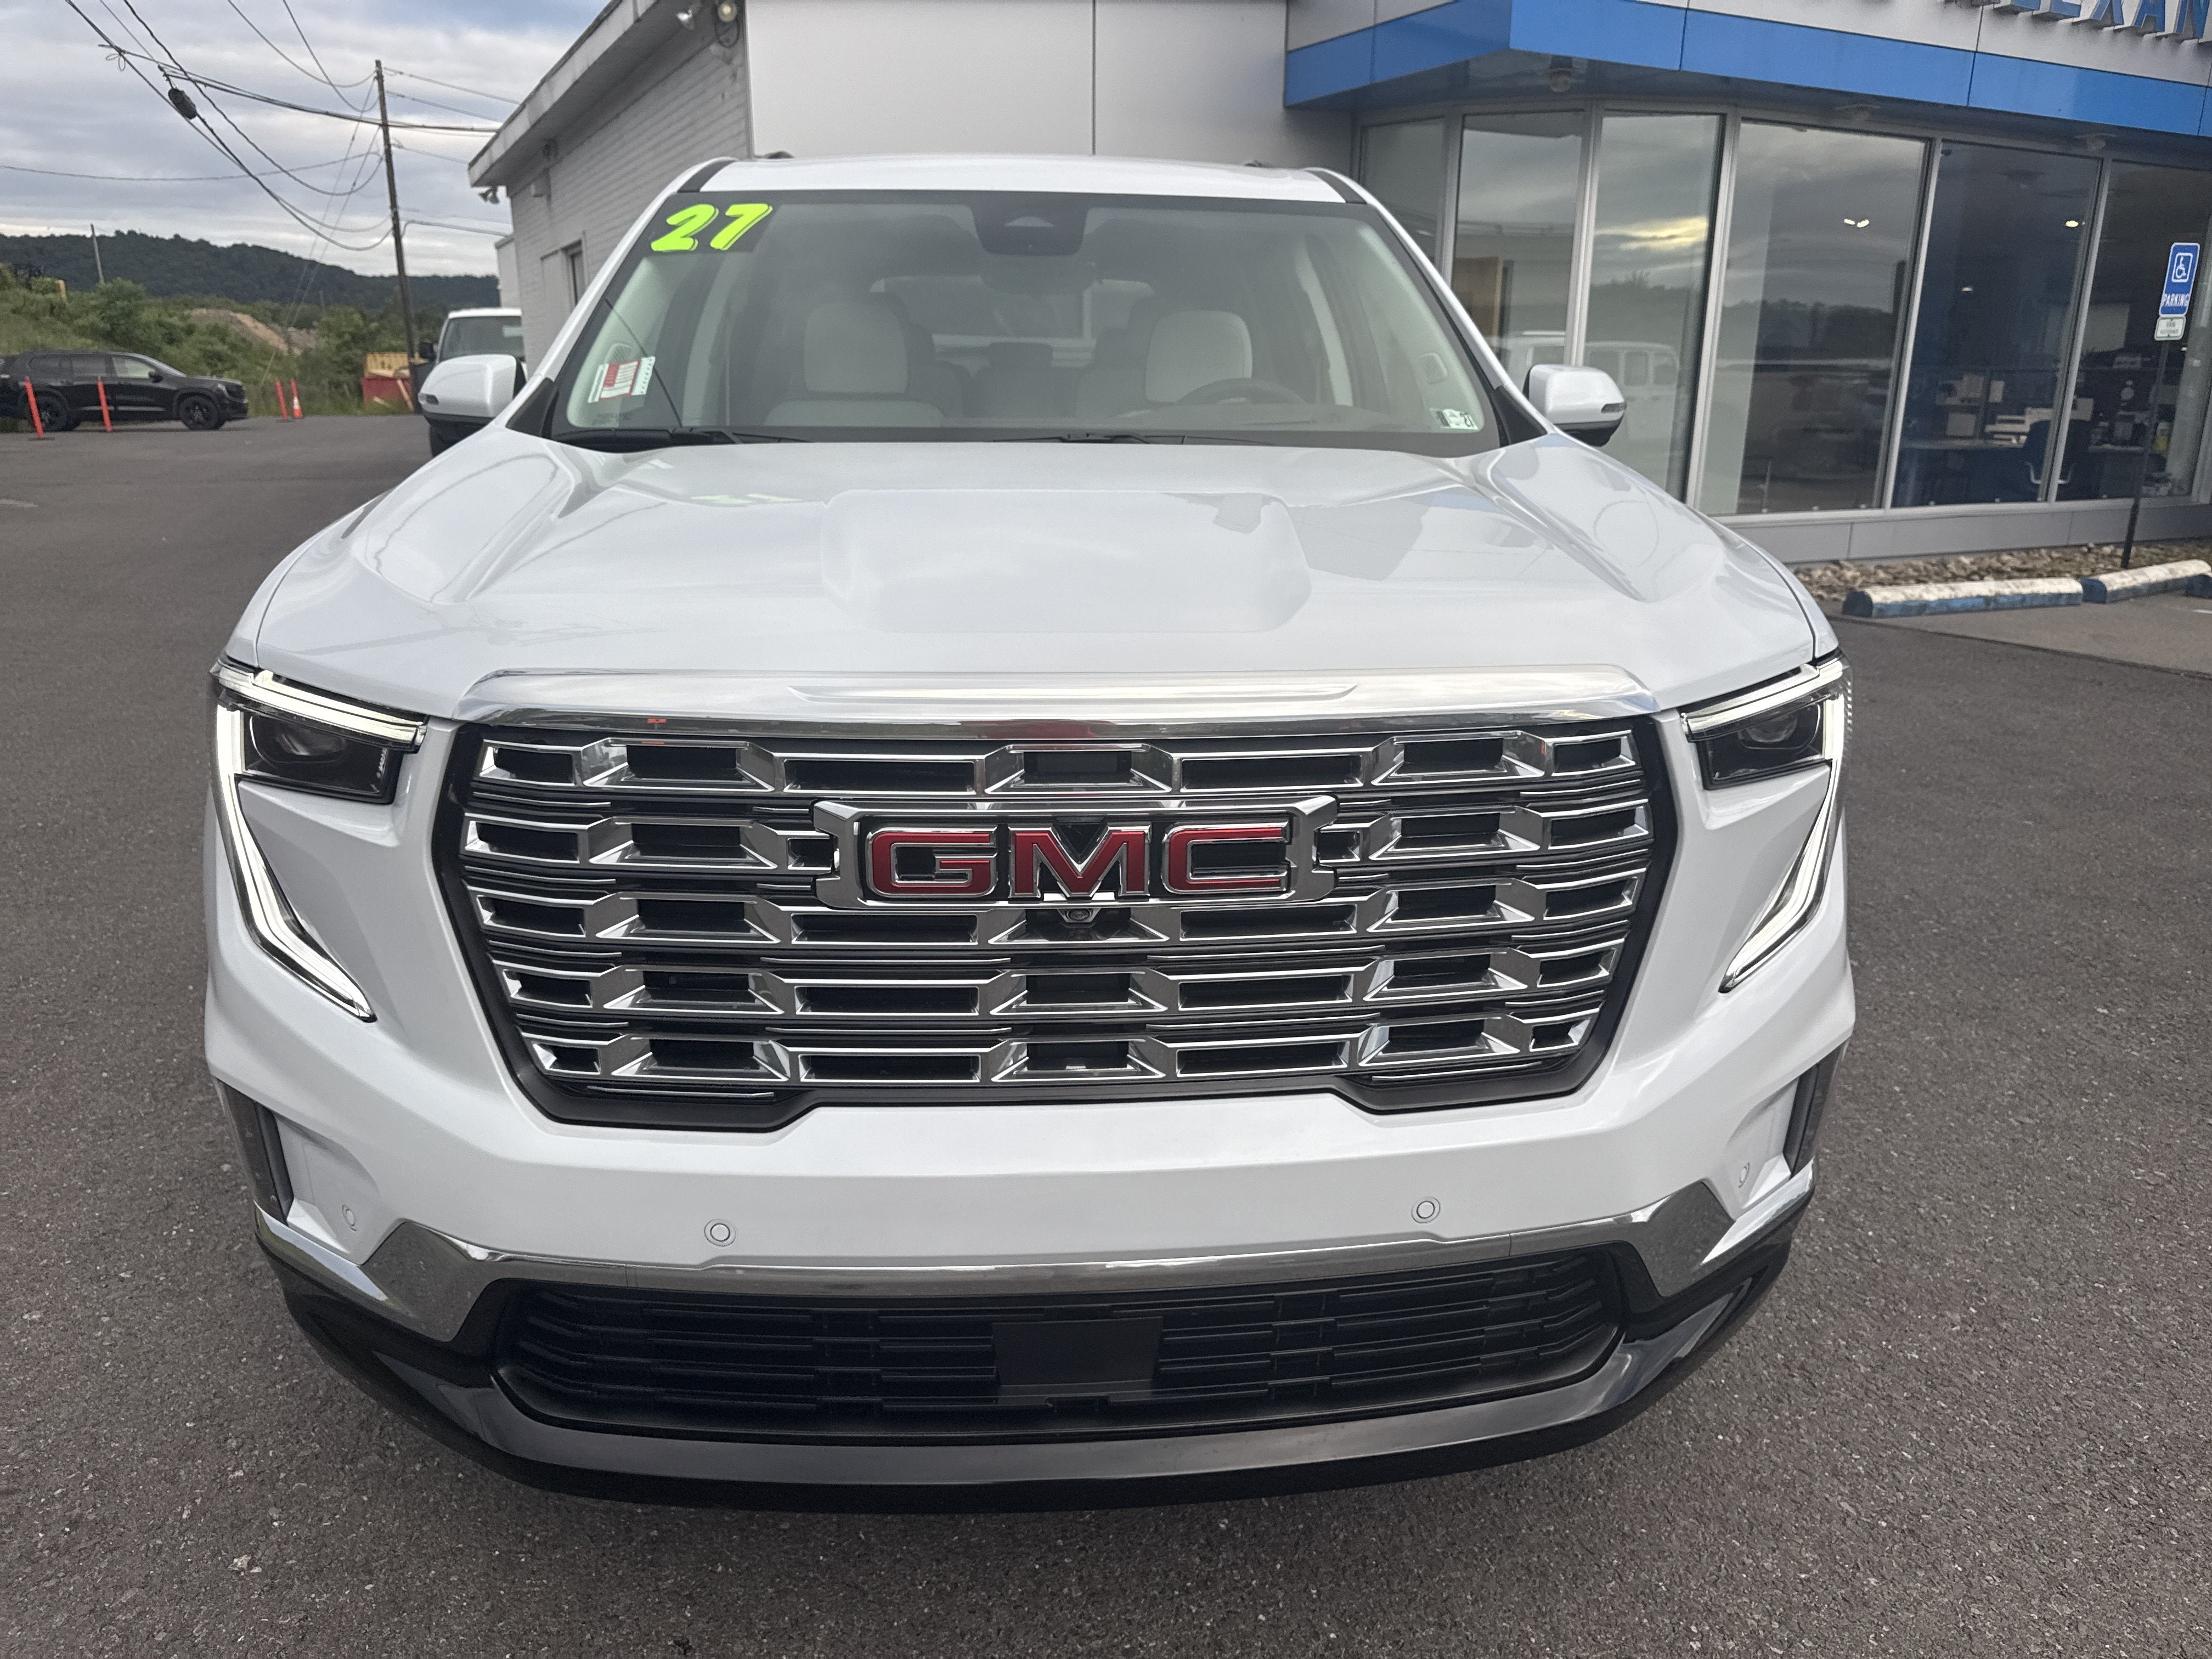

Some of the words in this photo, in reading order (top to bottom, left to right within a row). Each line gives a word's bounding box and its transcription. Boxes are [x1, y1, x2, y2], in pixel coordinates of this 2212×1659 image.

[651, 203, 773, 252] 27
[2162, 294, 2190, 307] PARKING
[866, 821, 1288, 899] GMC
